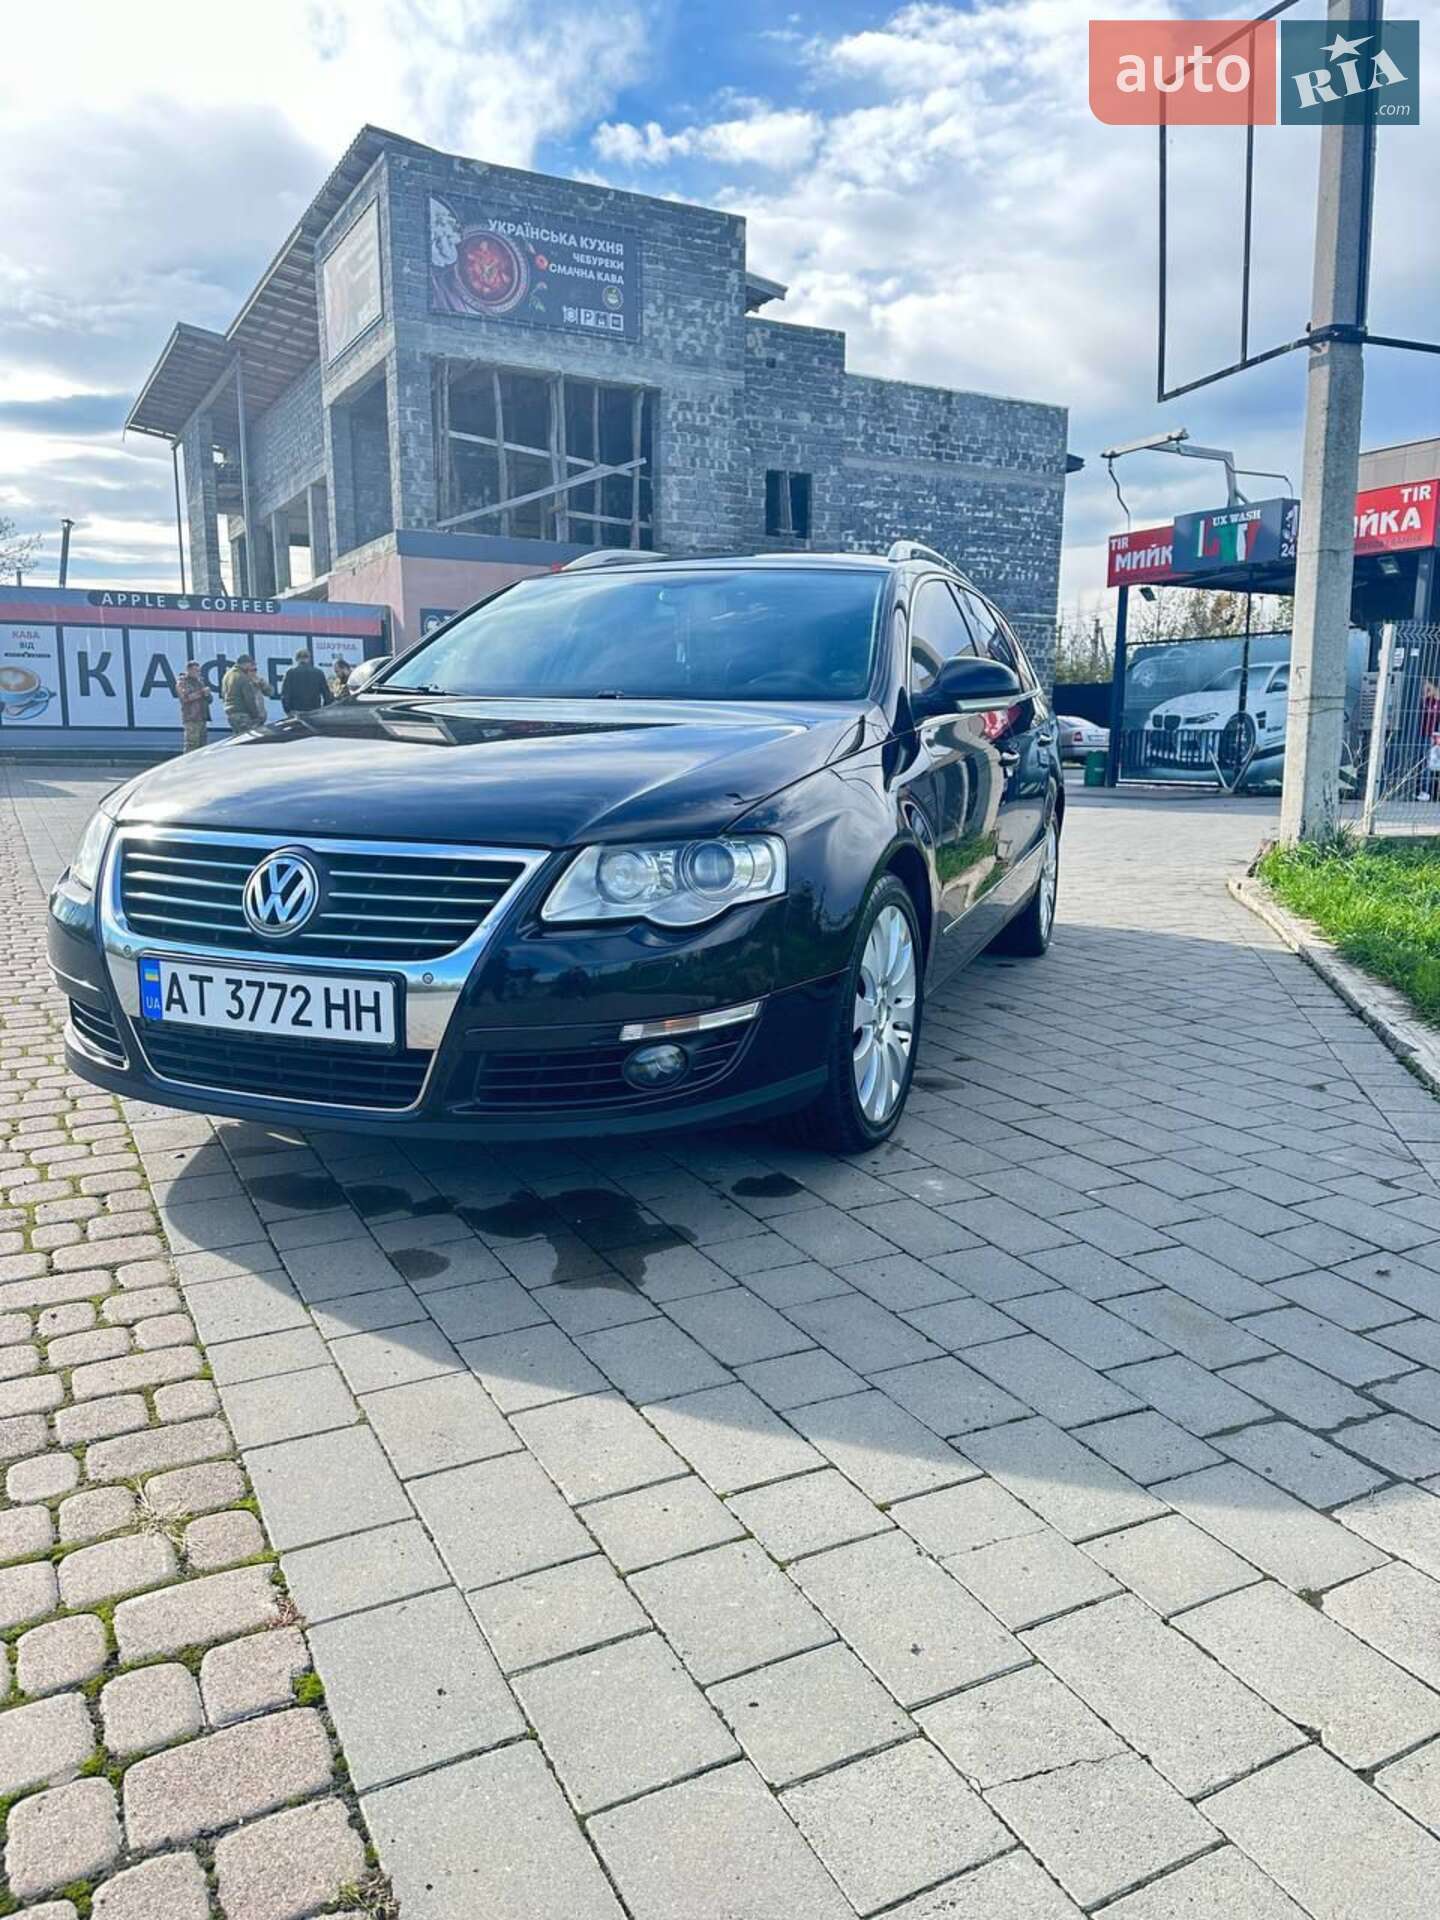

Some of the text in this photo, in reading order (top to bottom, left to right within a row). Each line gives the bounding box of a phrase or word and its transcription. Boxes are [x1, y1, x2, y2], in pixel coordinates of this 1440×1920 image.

[487, 218, 624, 256] УКРАЇНСЬКА КУХНЯ
[572, 252, 624, 271] ЧЕБУРЕКИ
[549, 263, 624, 286] СМАЧНА КАВА
[1401, 484, 1431, 503] TIR
[1229, 509, 1261, 524] WASH
[1354, 507, 1421, 539] ЙКА
[1110, 536, 1129, 551] TIR
[1115, 543, 1173, 572] МИЙК
[101, 592, 275, 614] APPLE COFFEE
[146, 995, 161, 1010] UA
[165, 971, 382, 1033] AT 3772 HH
